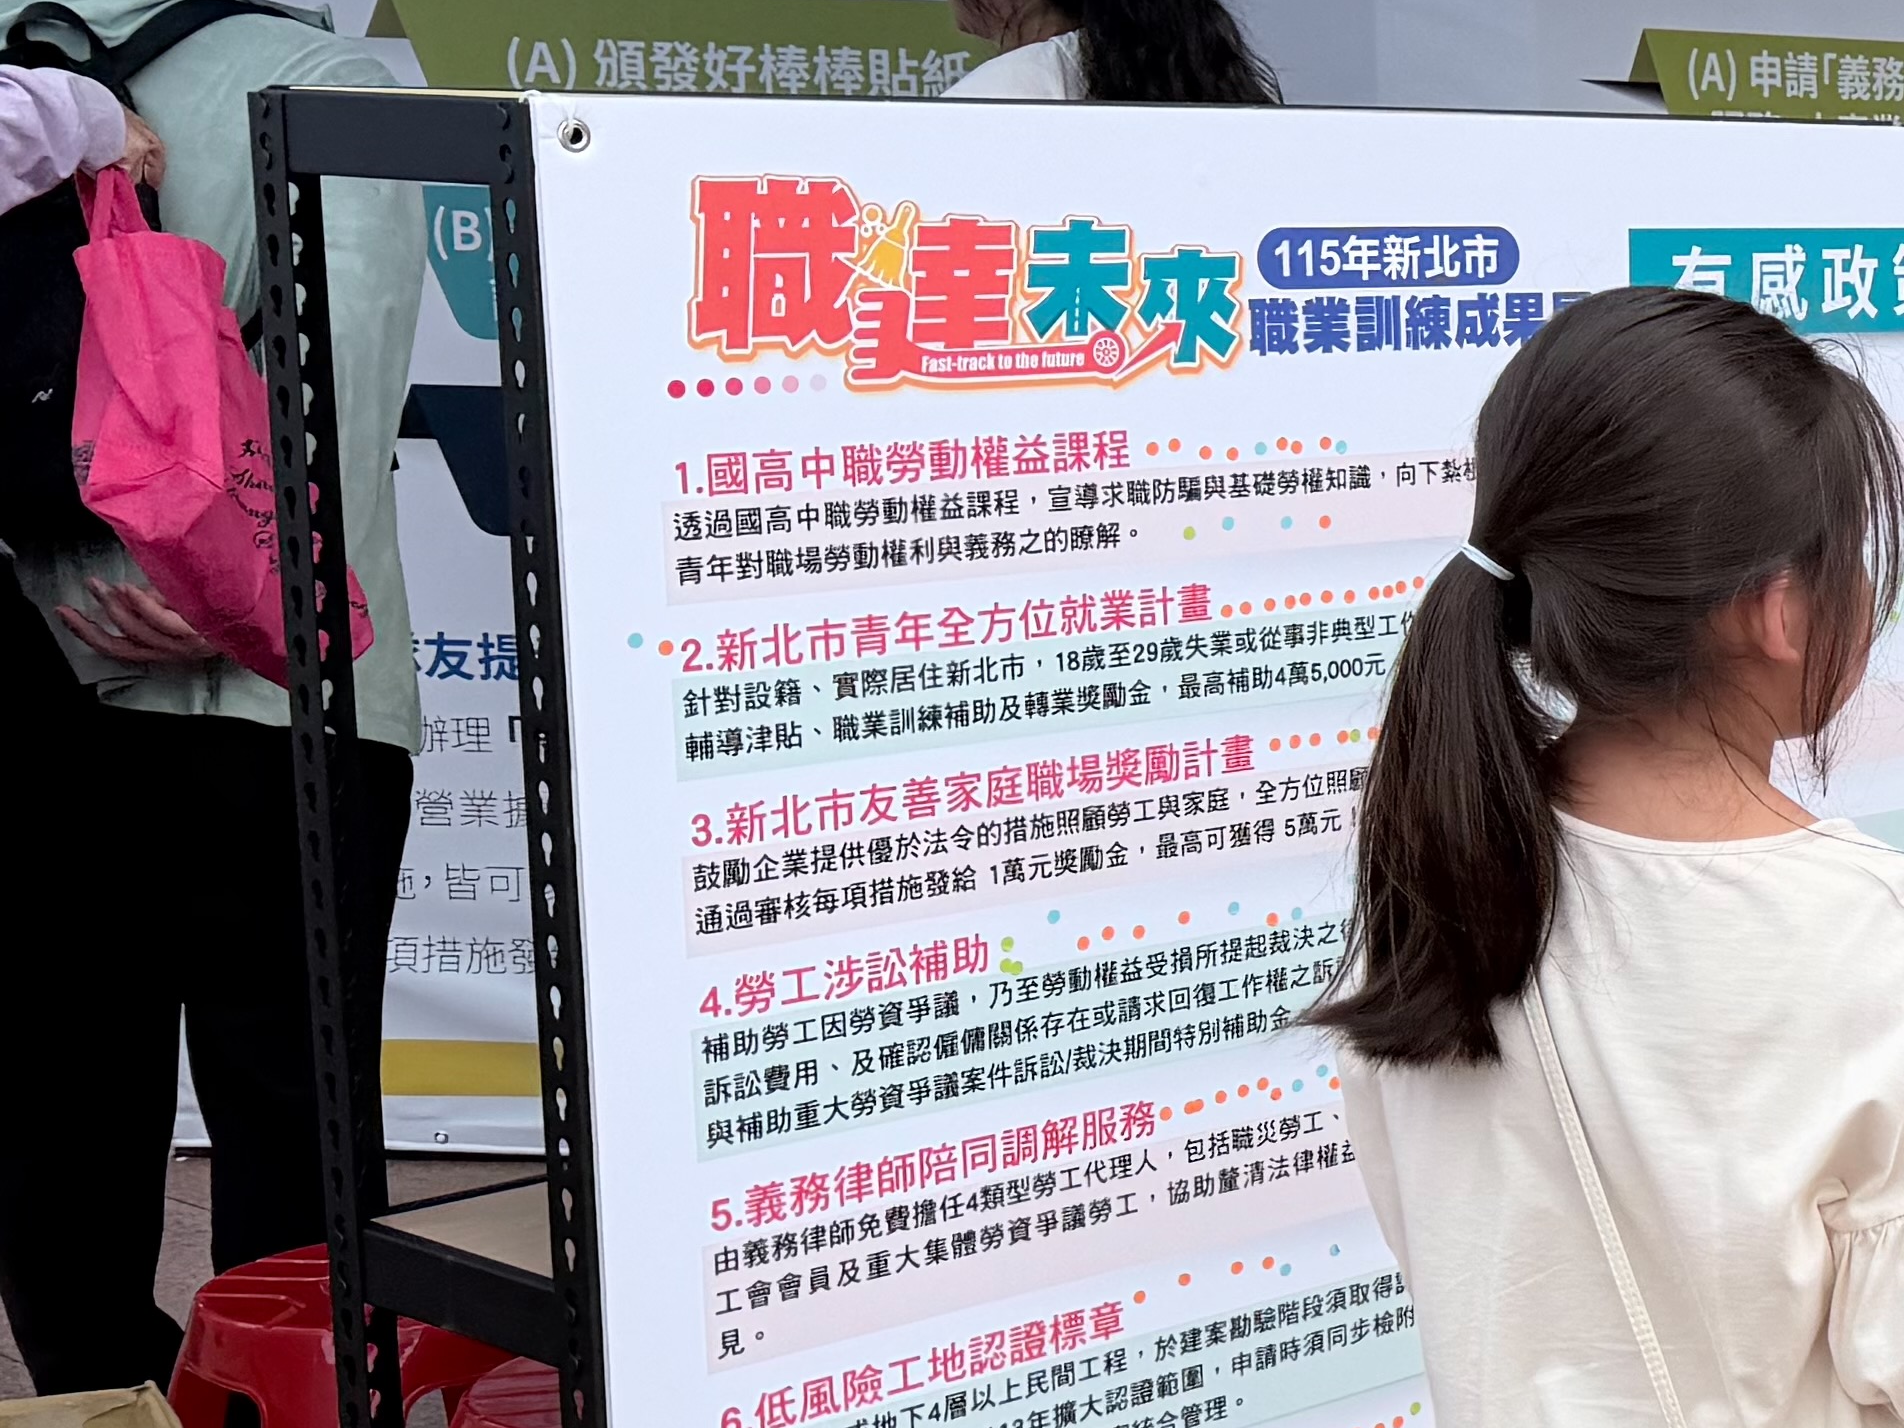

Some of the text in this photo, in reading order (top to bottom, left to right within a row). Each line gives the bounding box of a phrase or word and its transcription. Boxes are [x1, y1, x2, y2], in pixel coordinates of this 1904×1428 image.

[508, 36, 969, 96] (A) 頒發好棒棒貼紙
[1688, 48, 1736, 101] (A)
[1274, 234, 1500, 281] 115年新北市
[922, 352, 1085, 372] Fast-track to the future
[675, 430, 1130, 498] 1.國高中職勞動權益課程
[411, 632, 519, 681] 友提
[681, 583, 1212, 673] 2.新北市青年全方位就業計畫
[692, 734, 1254, 847] 3.新北市友善家庭職場獎勵計畫
[700, 934, 988, 1018] 4.勞工涉訟補助
[703, 956, 1343, 1107] 訴訟費用、及確認僱傭關係存在或請求回復工作權之訴
[710, 1101, 1156, 1232] 5.義務律師陪同調解服務
[717, 1327, 765, 1362] 見。
